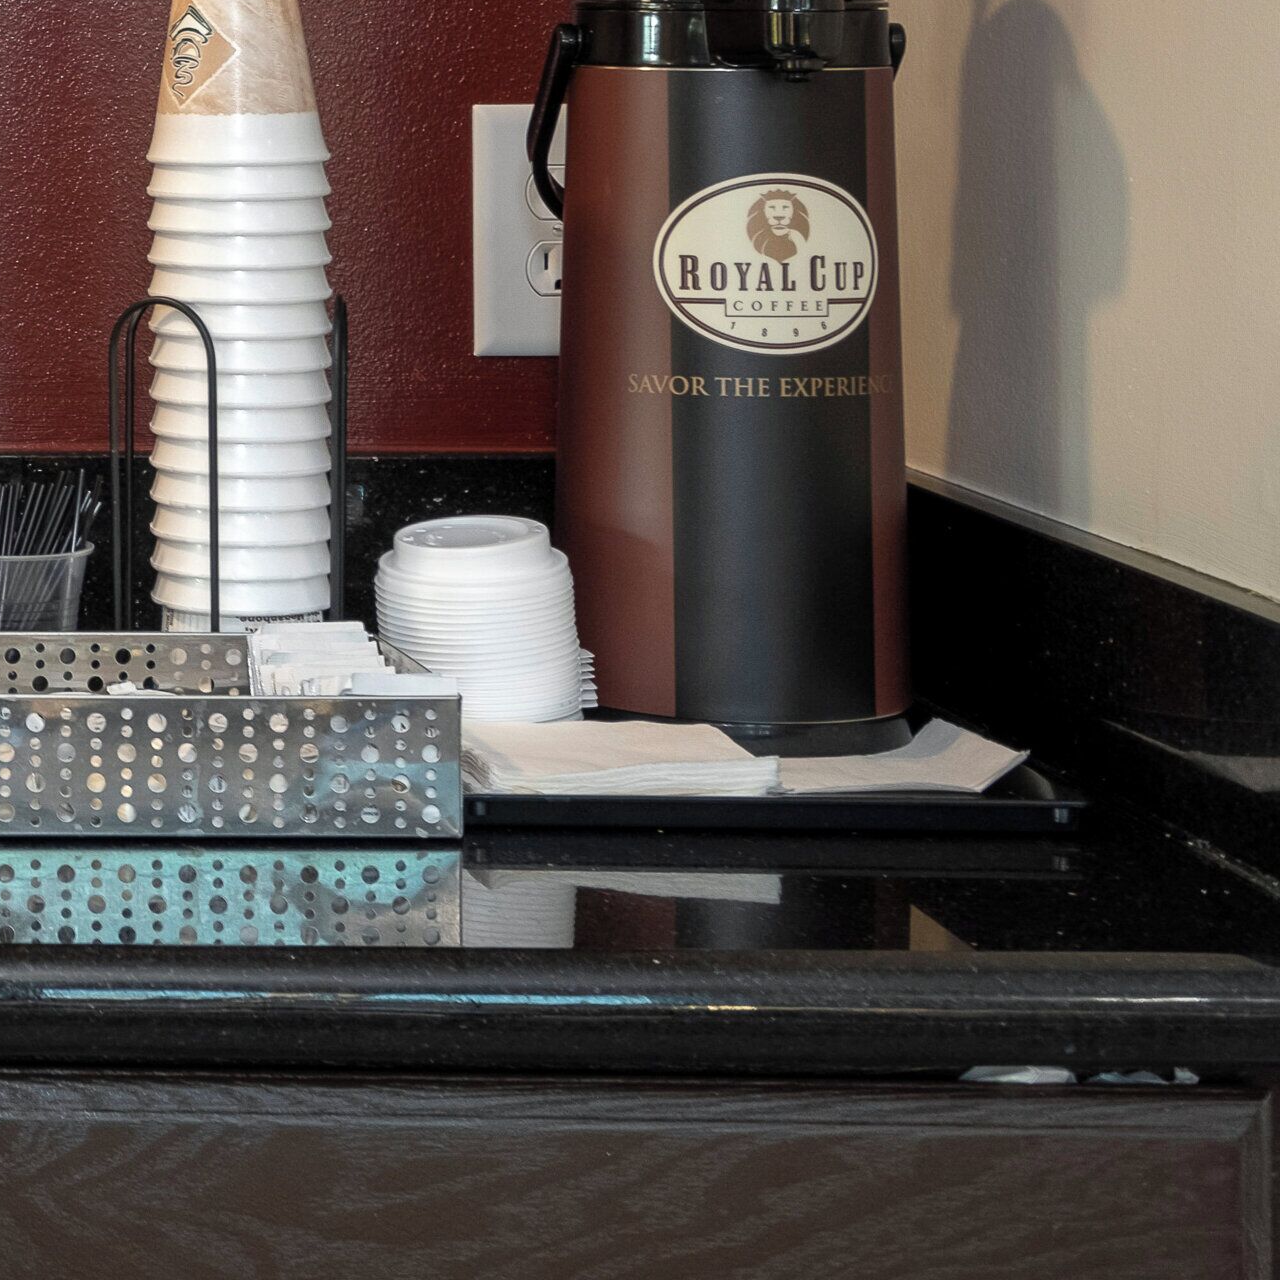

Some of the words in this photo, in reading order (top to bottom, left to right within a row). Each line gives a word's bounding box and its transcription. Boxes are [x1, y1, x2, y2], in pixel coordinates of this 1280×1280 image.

[678, 254, 796, 291] ROYAL
[810, 255, 865, 291] CUP
[733, 300, 824, 312] COFFEE
[628, 373, 711, 396] SAVOR
[715, 377, 771, 397] THE
